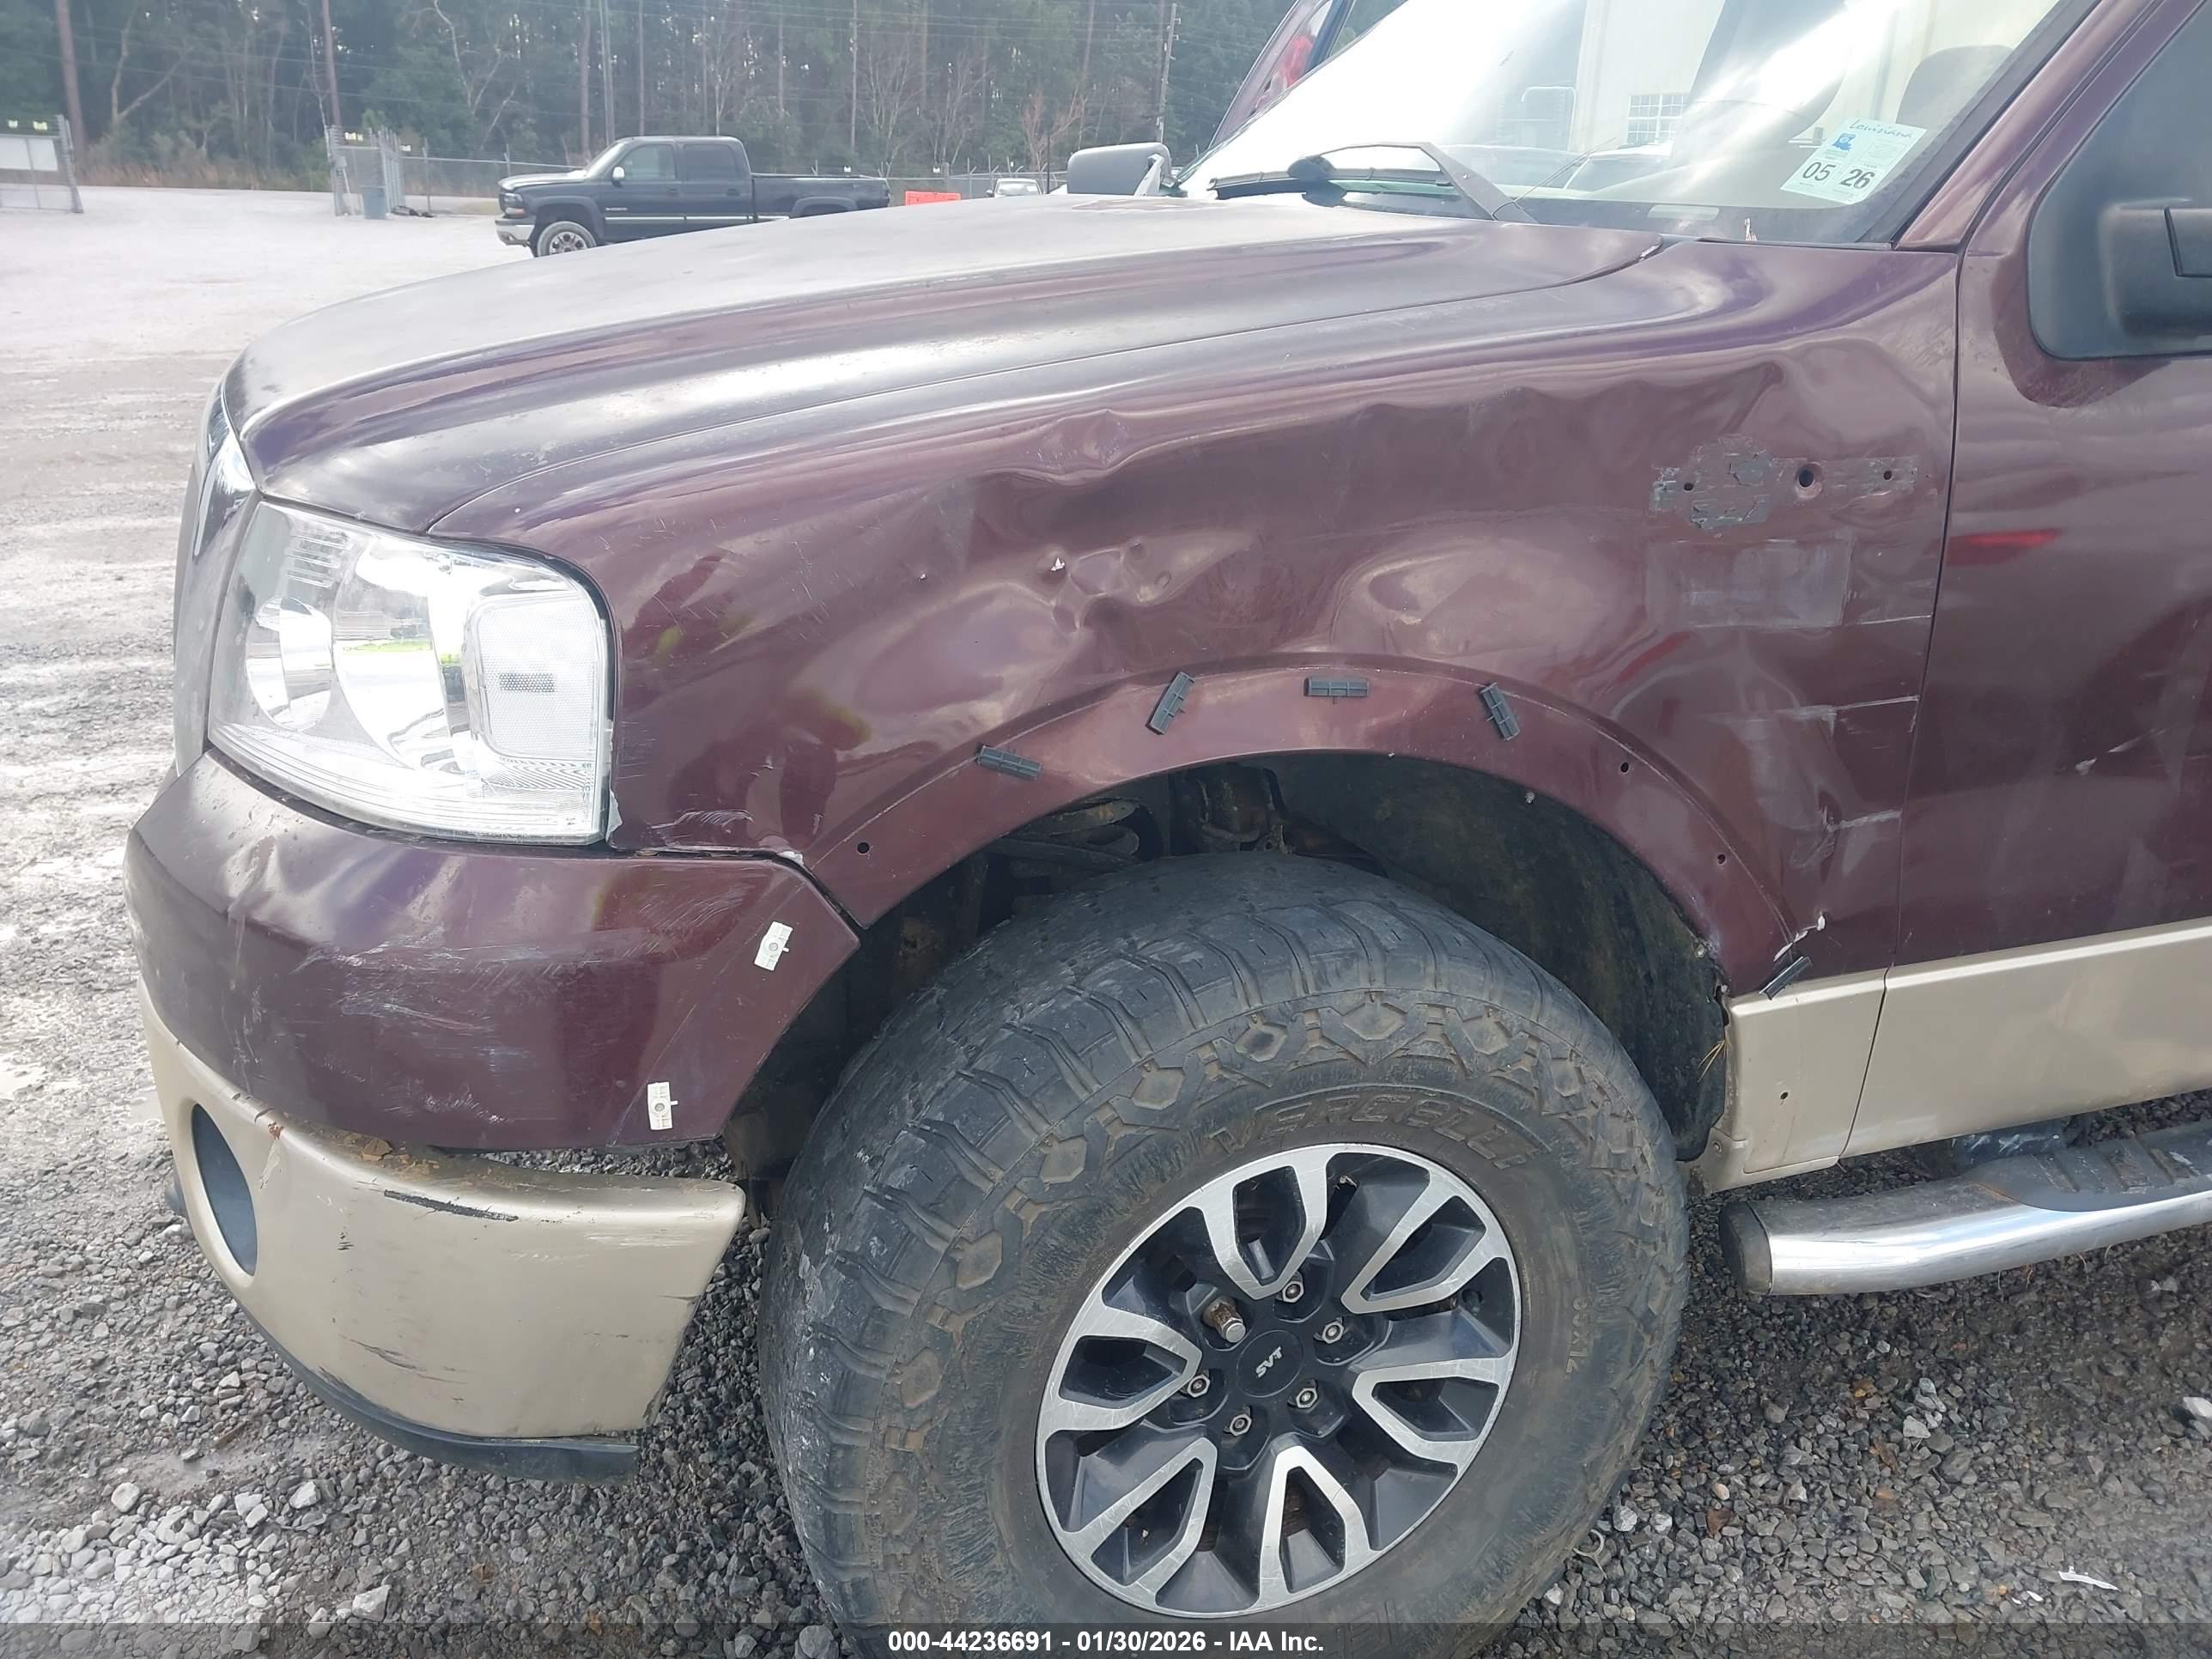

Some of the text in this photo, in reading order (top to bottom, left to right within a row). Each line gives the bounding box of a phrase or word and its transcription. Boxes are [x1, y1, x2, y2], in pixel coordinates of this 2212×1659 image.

[1849, 118, 1912, 139] Louisiana
[1802, 161, 1875, 190] 05 26
[1255, 1346, 1283, 1379] SVT
